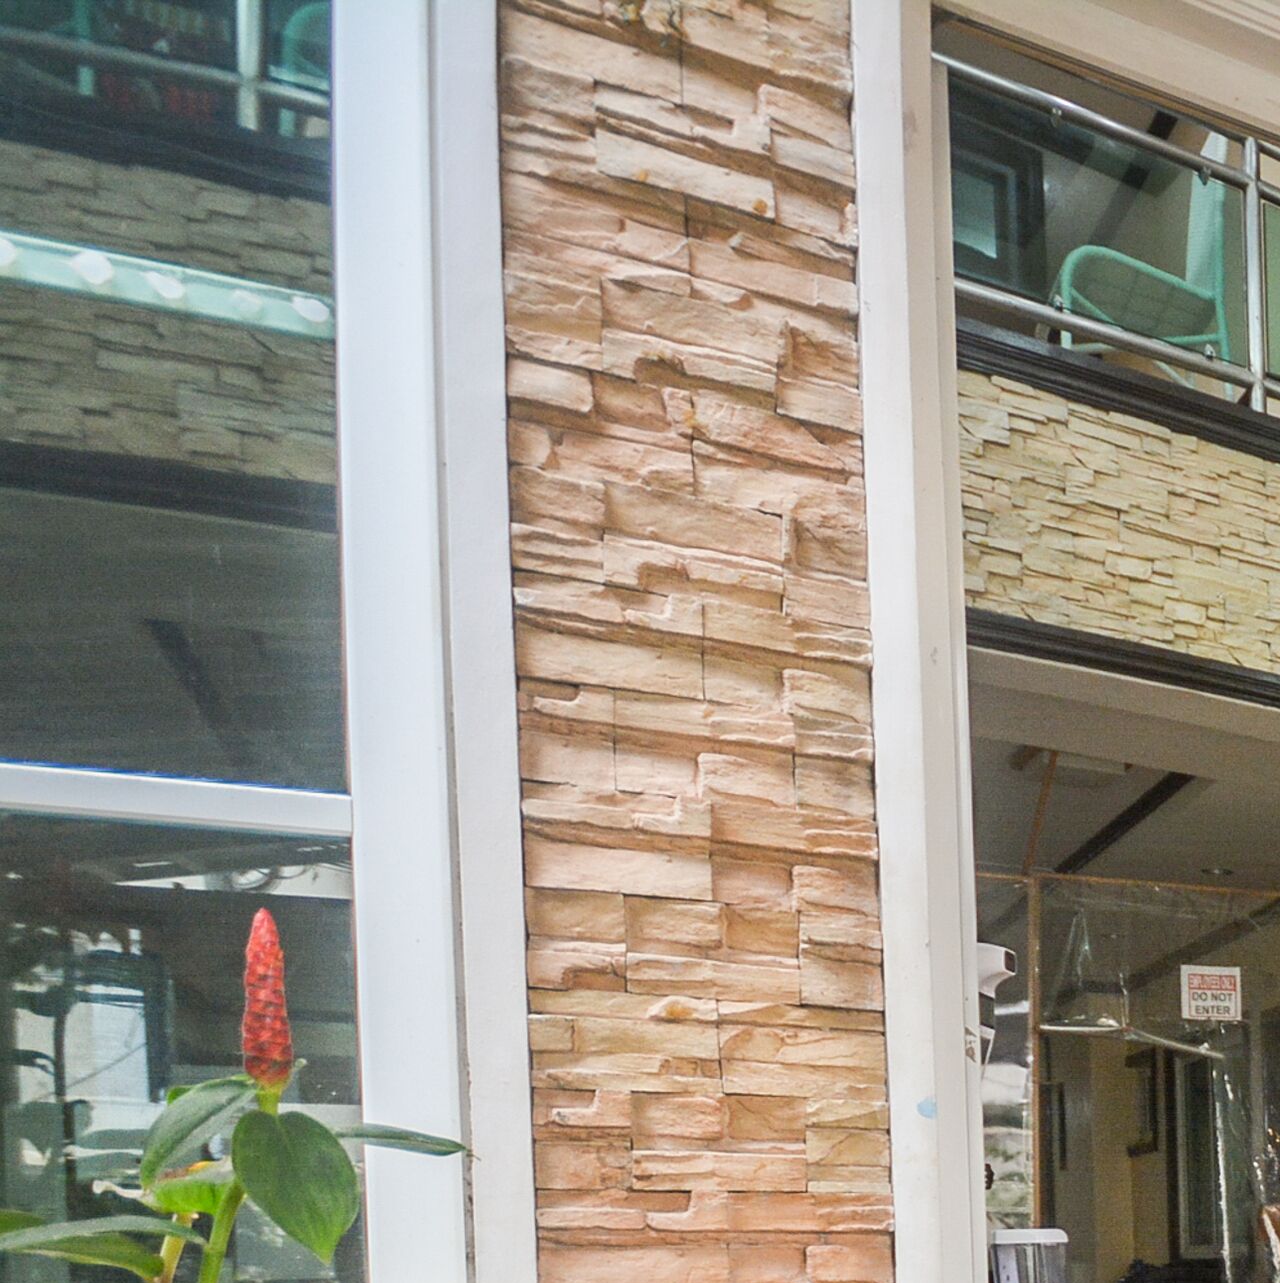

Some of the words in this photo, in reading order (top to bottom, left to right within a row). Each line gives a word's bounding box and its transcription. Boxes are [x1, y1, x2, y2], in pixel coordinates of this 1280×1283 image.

[1192, 991, 1208, 1001] DO
[1211, 992, 1233, 1001] NOT
[1195, 1005, 1231, 1015] ENTER
